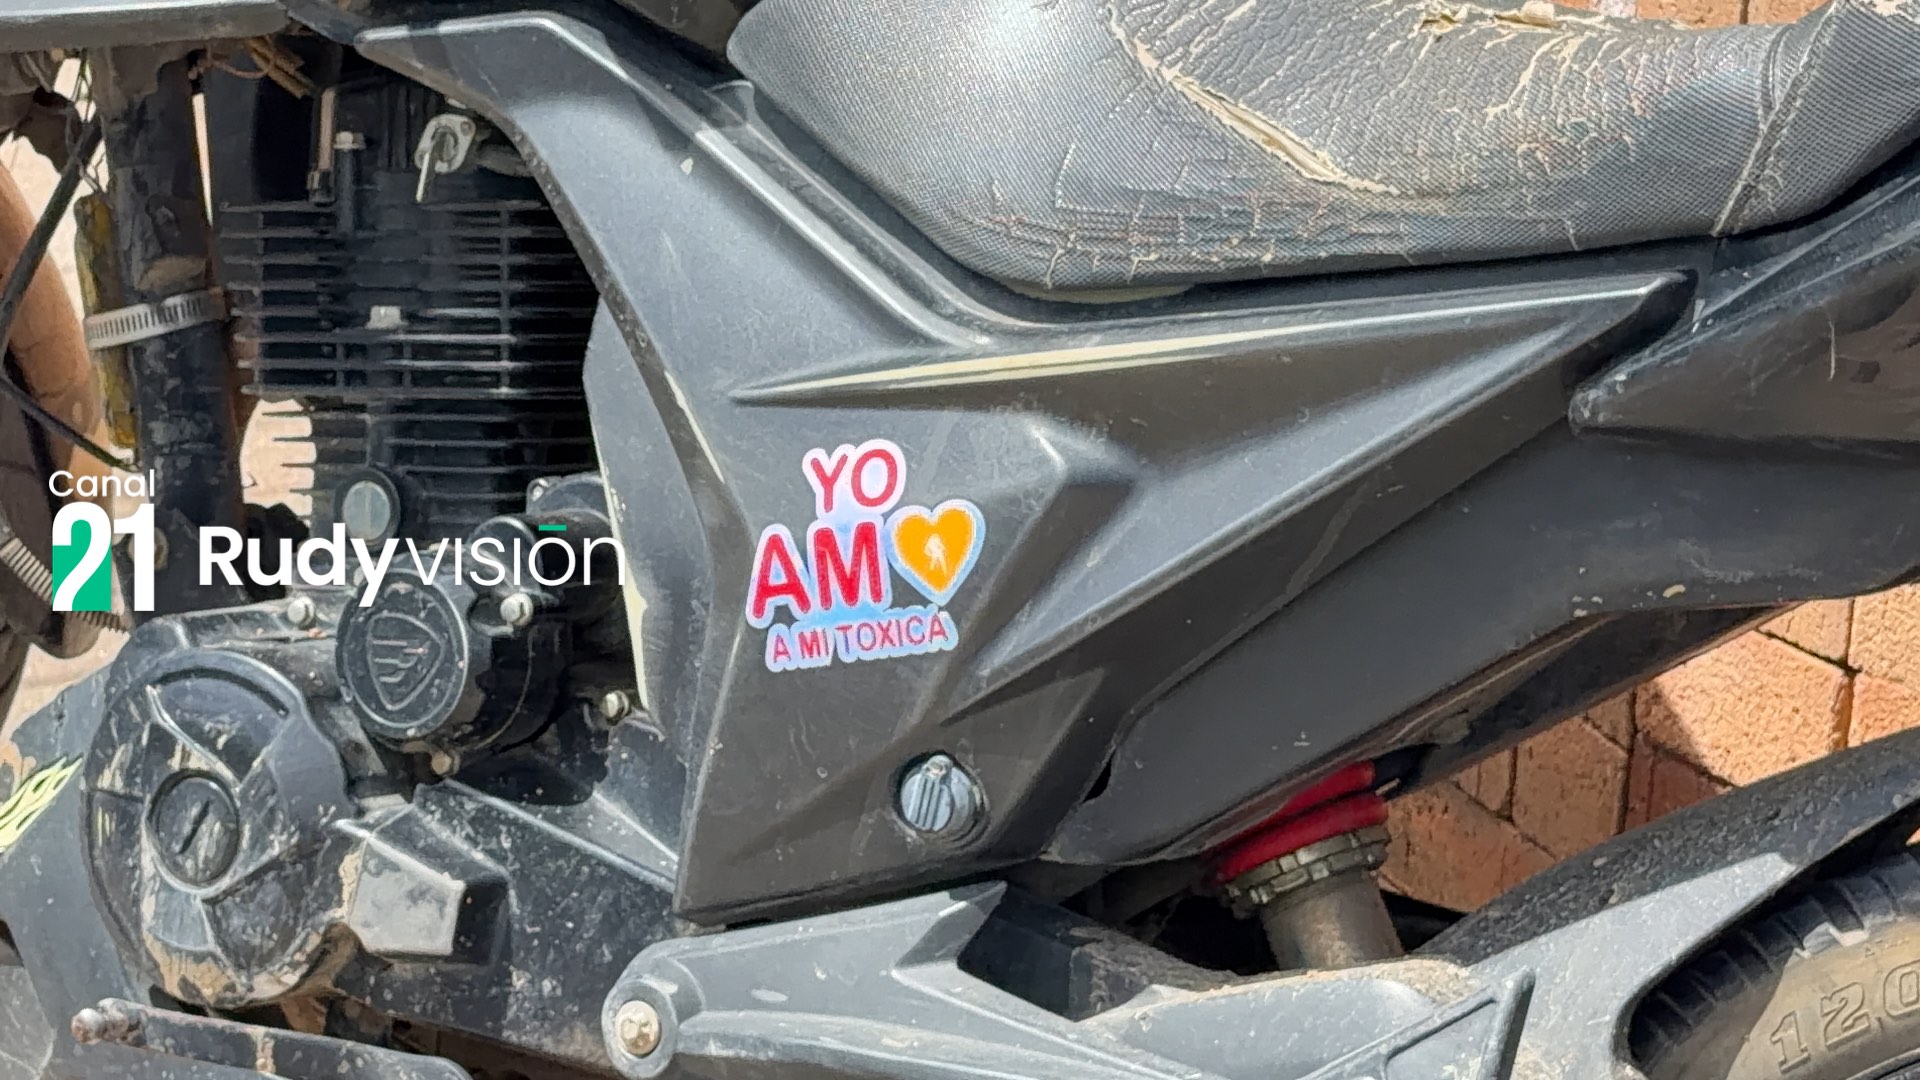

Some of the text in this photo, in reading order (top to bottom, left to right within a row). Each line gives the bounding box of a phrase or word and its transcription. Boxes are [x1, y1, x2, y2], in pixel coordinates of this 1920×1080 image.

[810, 448, 898, 513] YO
[772, 612, 949, 664] A MI TOXICA
[1770, 960, 1920, 1074] 120
